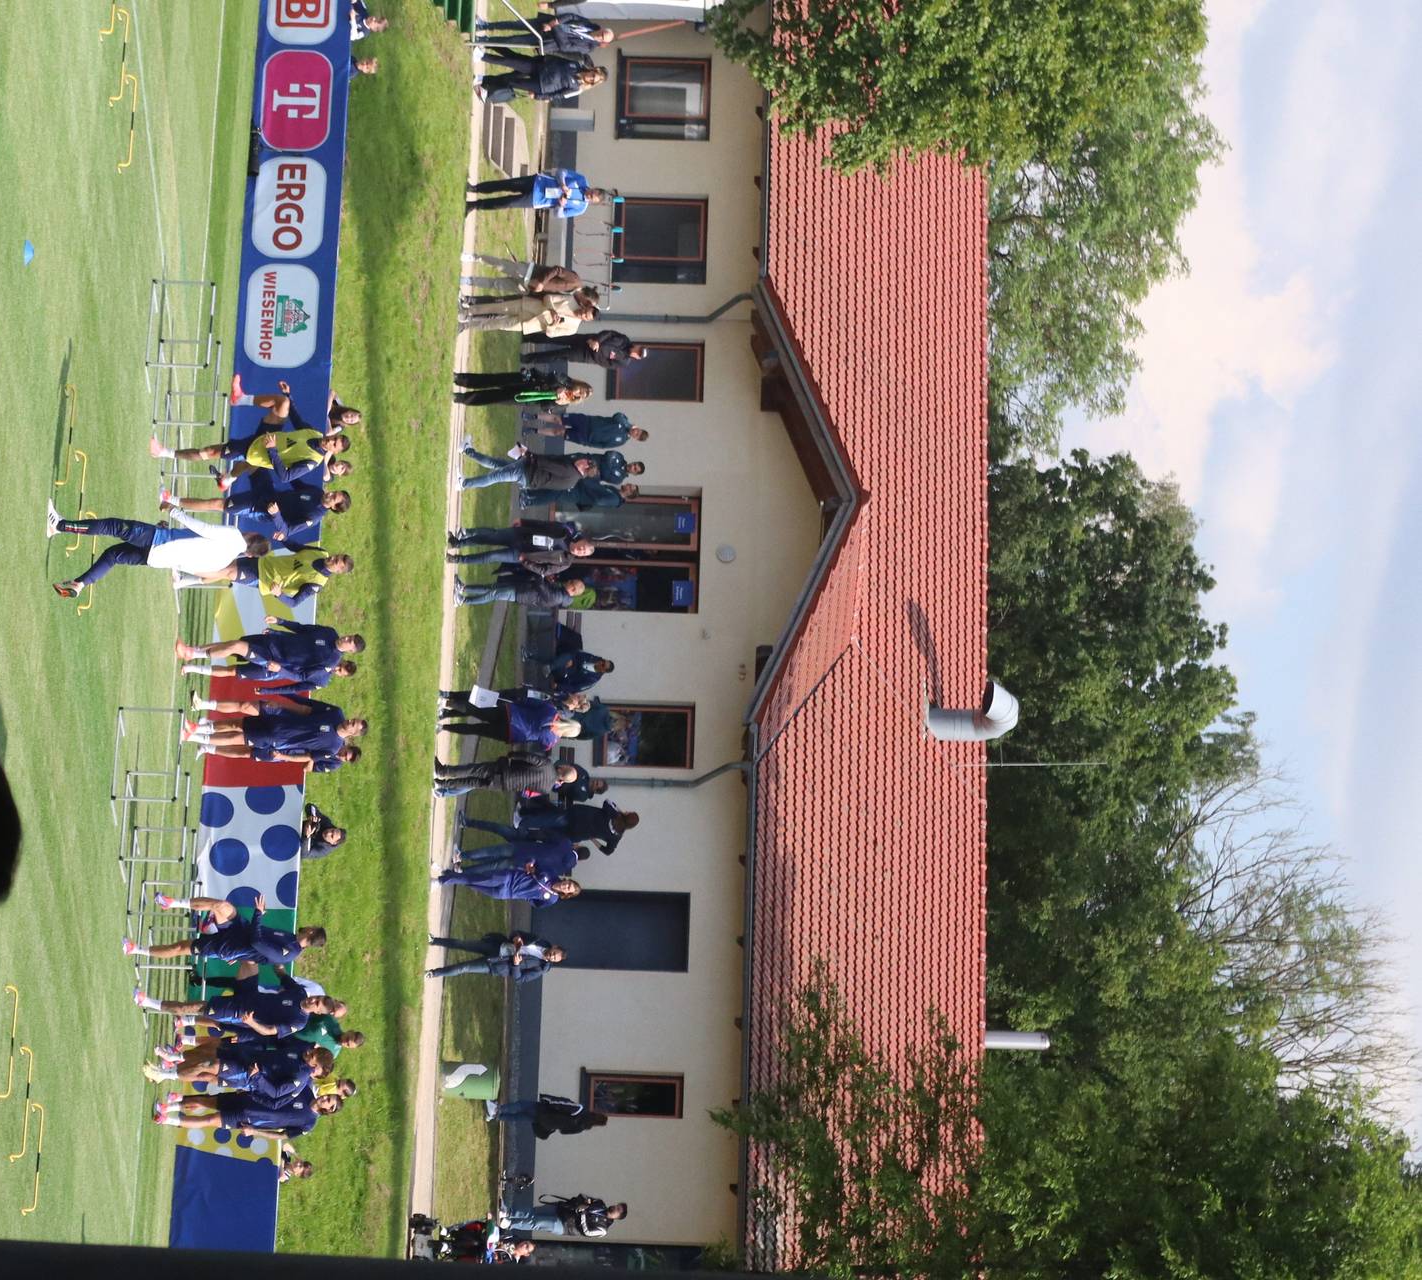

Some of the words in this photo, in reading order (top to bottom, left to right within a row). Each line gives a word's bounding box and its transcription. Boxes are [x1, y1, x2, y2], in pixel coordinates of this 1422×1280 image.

[272, 83, 321, 119] T
[272, 163, 307, 251] ERGO
[258, 271, 277, 361] WIESENHOF
